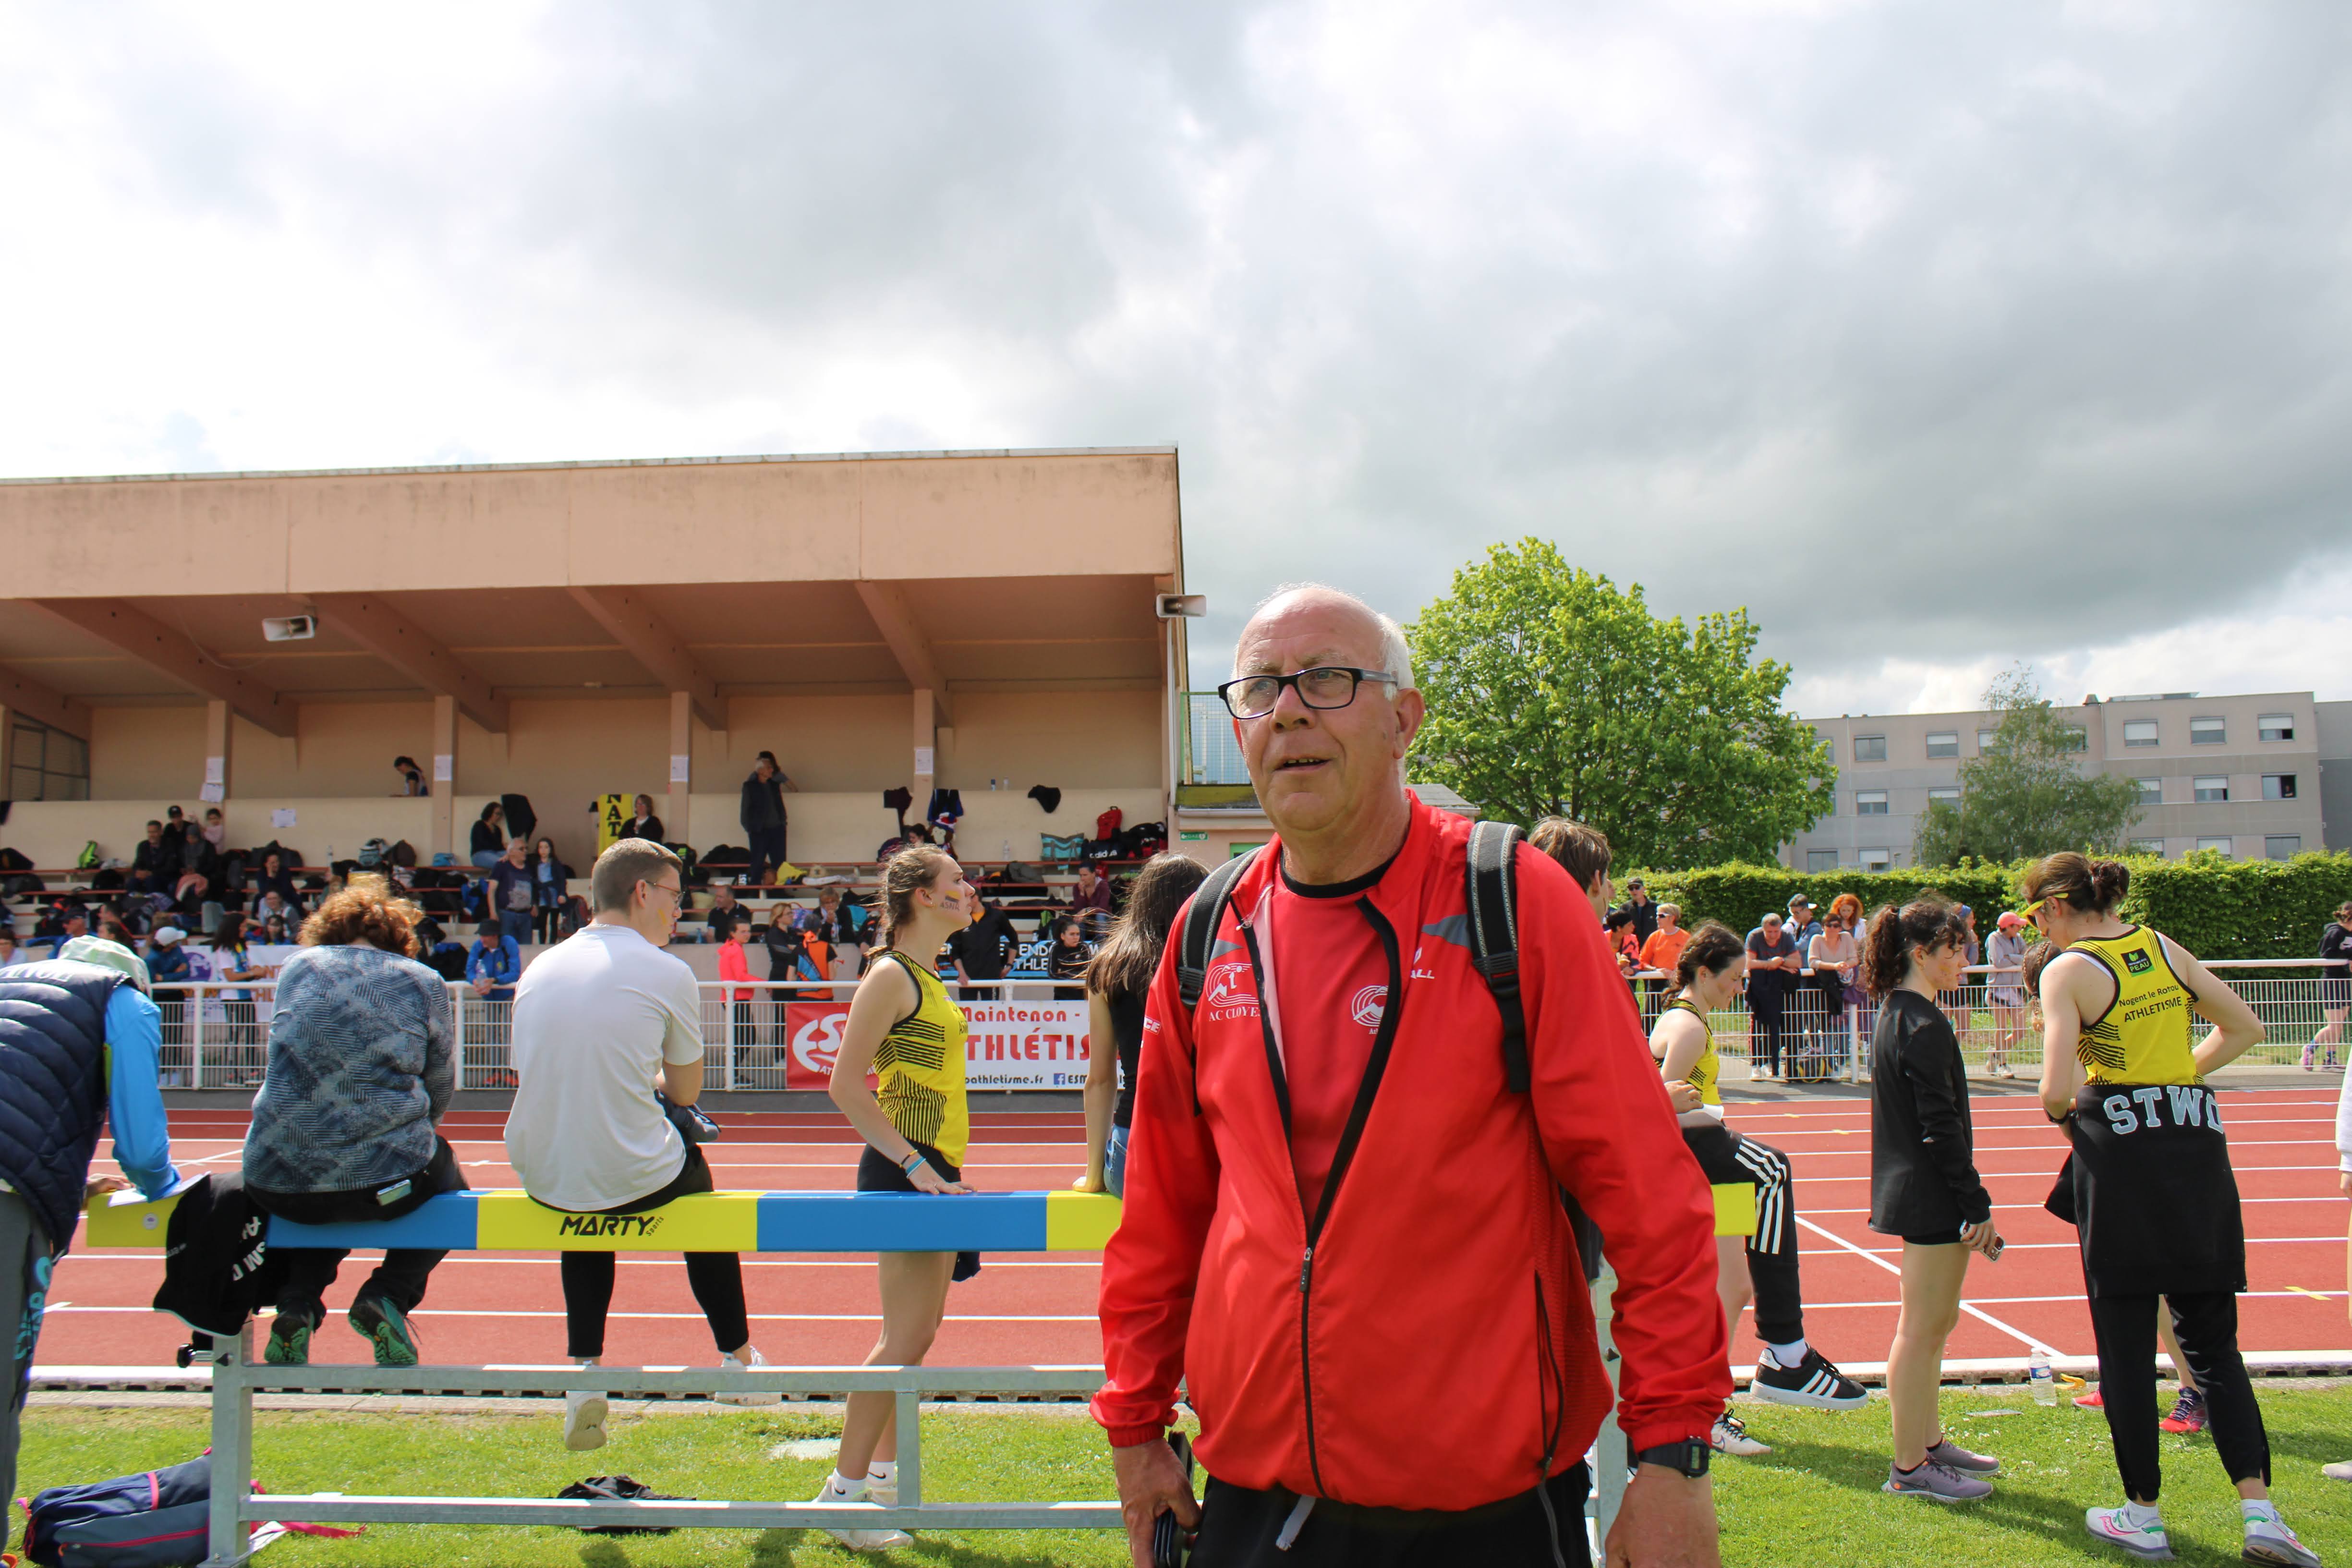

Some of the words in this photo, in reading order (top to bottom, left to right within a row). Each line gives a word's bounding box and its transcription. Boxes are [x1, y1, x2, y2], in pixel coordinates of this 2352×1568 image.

[2130, 961, 2149, 972] PEAU
[2119, 994, 2147, 1007] Nogent
[2157, 985, 2179, 996] Rotrou
[959, 1007, 1066, 1022] Maintenon
[1209, 1010, 1223, 1021] AC
[2124, 997, 2182, 1022] ATHLETISME
[967, 1027, 1089, 1061] THLÉTIS
[559, 1216, 655, 1236] MARTY
[646, 1216, 664, 1237] Sports
